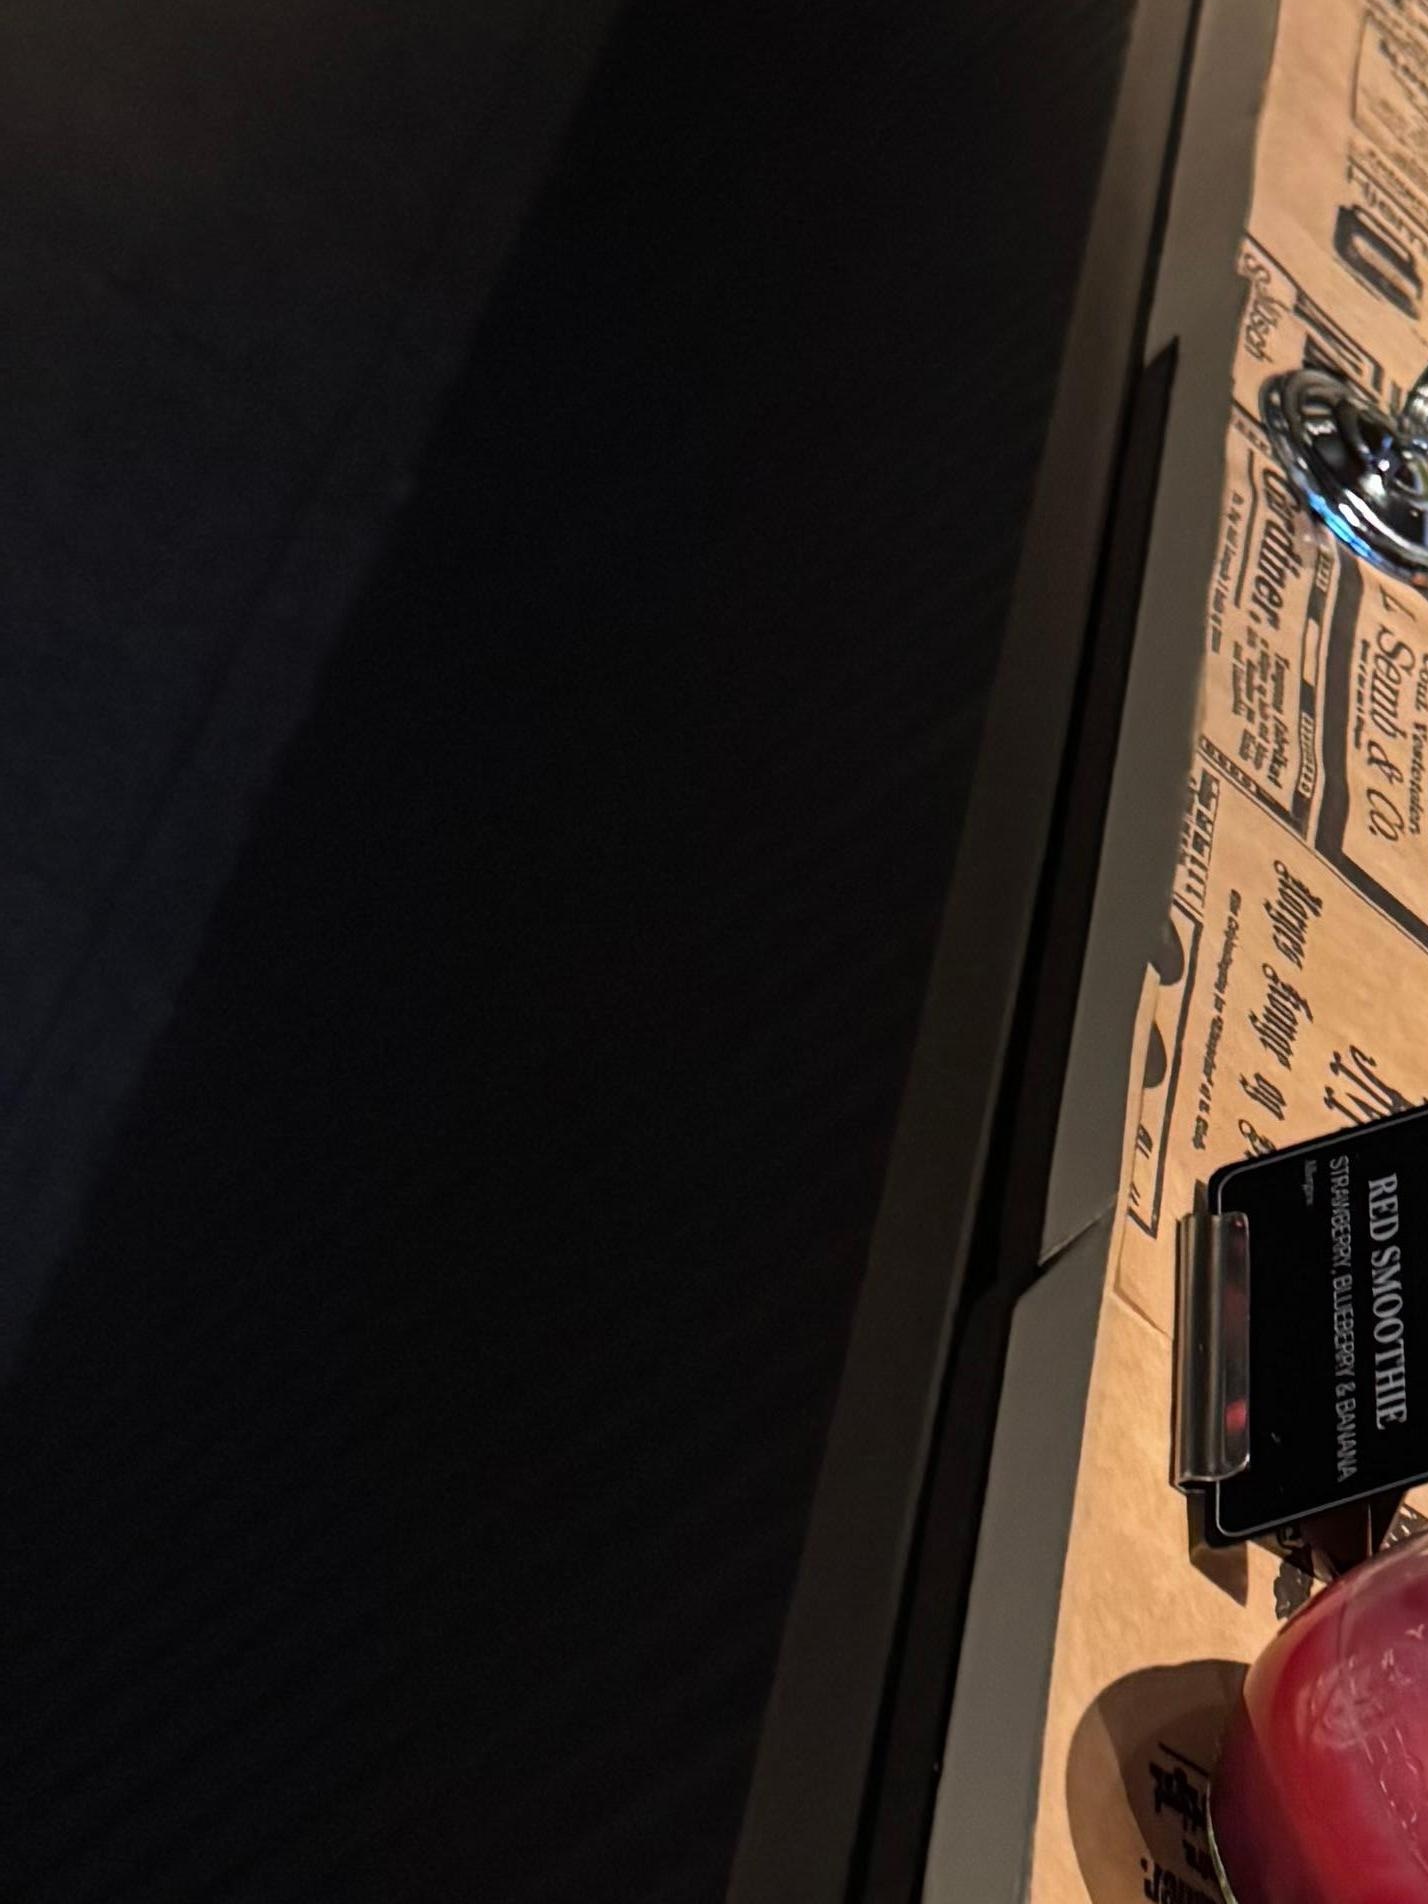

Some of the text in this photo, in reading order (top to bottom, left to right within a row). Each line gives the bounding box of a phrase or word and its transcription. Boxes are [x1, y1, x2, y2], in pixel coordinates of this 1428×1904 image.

[1370, 621, 1413, 741] Semb
[1366, 735, 1403, 783] &
[1239, 1073, 1286, 1120] og
[1327, 1154, 1357, 1482] STRAWBERRY, BLUEBERRY & BANANA
[1368, 1172, 1406, 1431] RED SMOOTHIE
